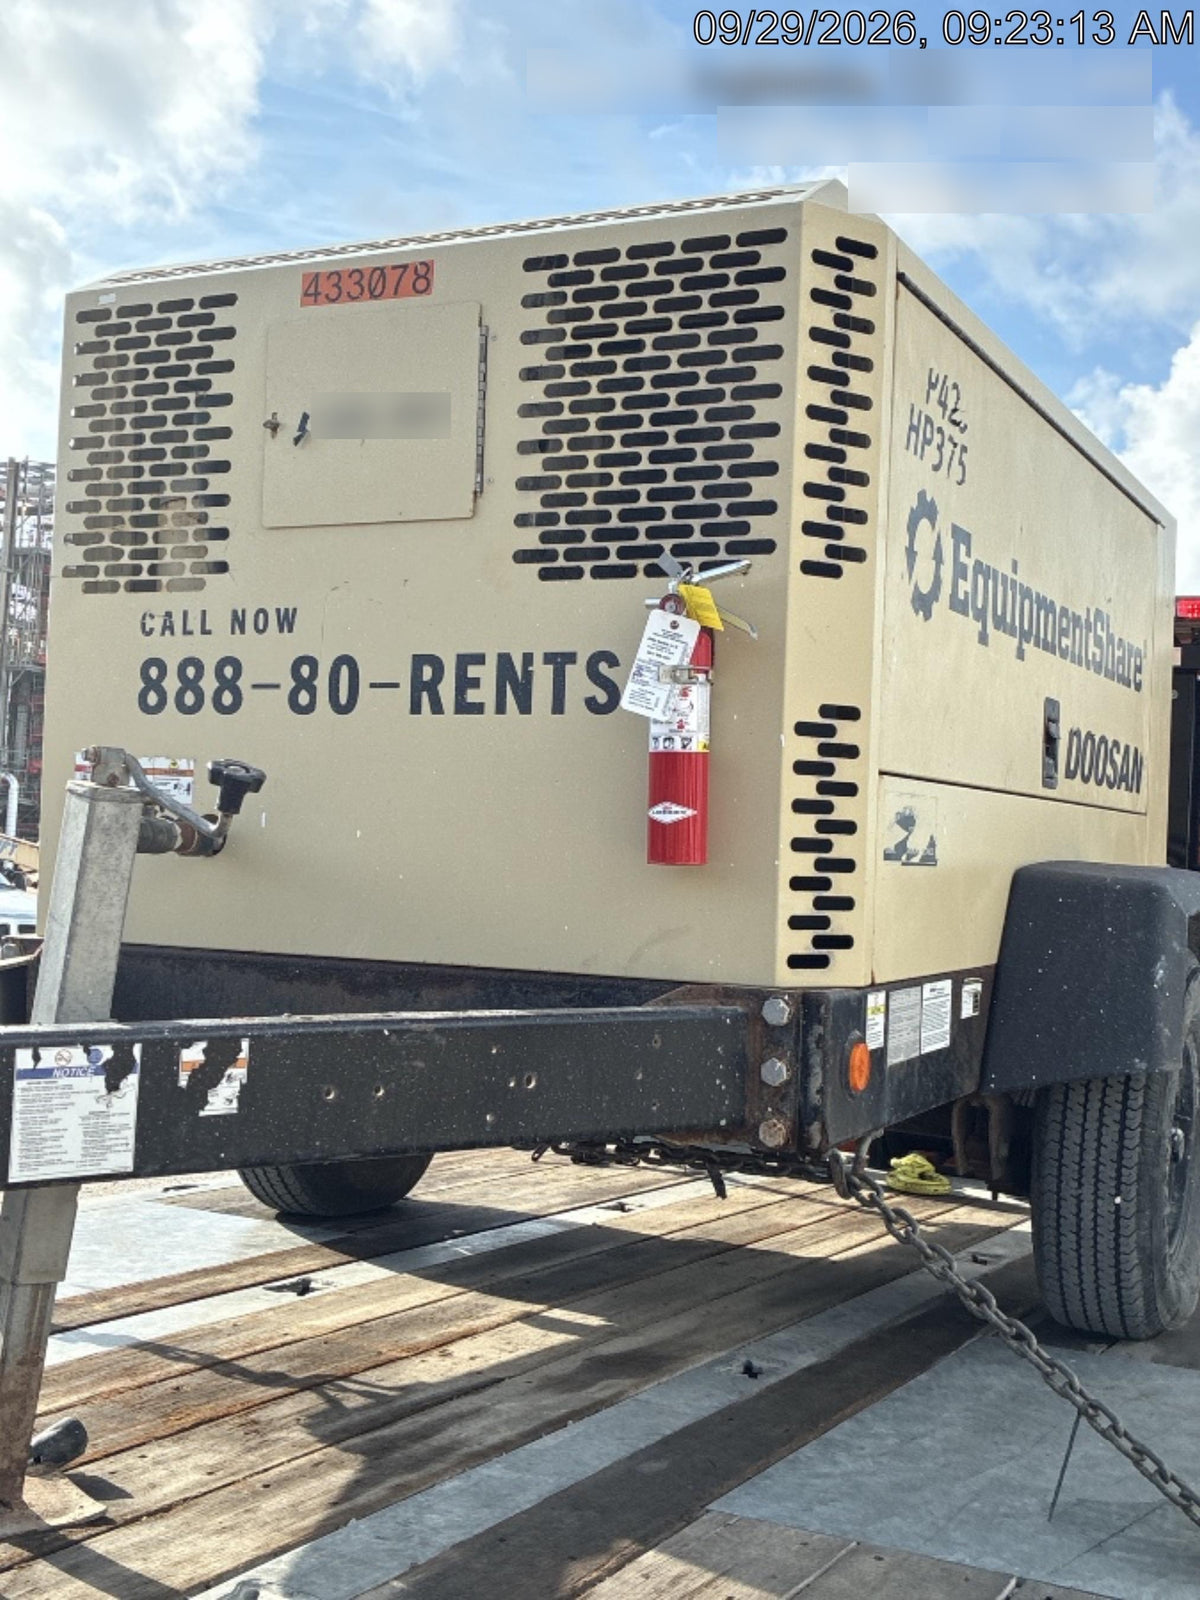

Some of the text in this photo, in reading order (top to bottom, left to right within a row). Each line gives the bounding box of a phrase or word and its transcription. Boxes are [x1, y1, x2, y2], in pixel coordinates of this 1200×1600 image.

[303, 261, 431, 303] 433078
[905, 403, 969, 486] HP375
[140, 607, 298, 637] CALL NOW
[949, 523, 1143, 693] EquipmentShare
[137, 650, 621, 715] 888-80-RENTS
[1065, 727, 1143, 794] DOOSAN
[52, 1067, 96, 1078] NOTICE
